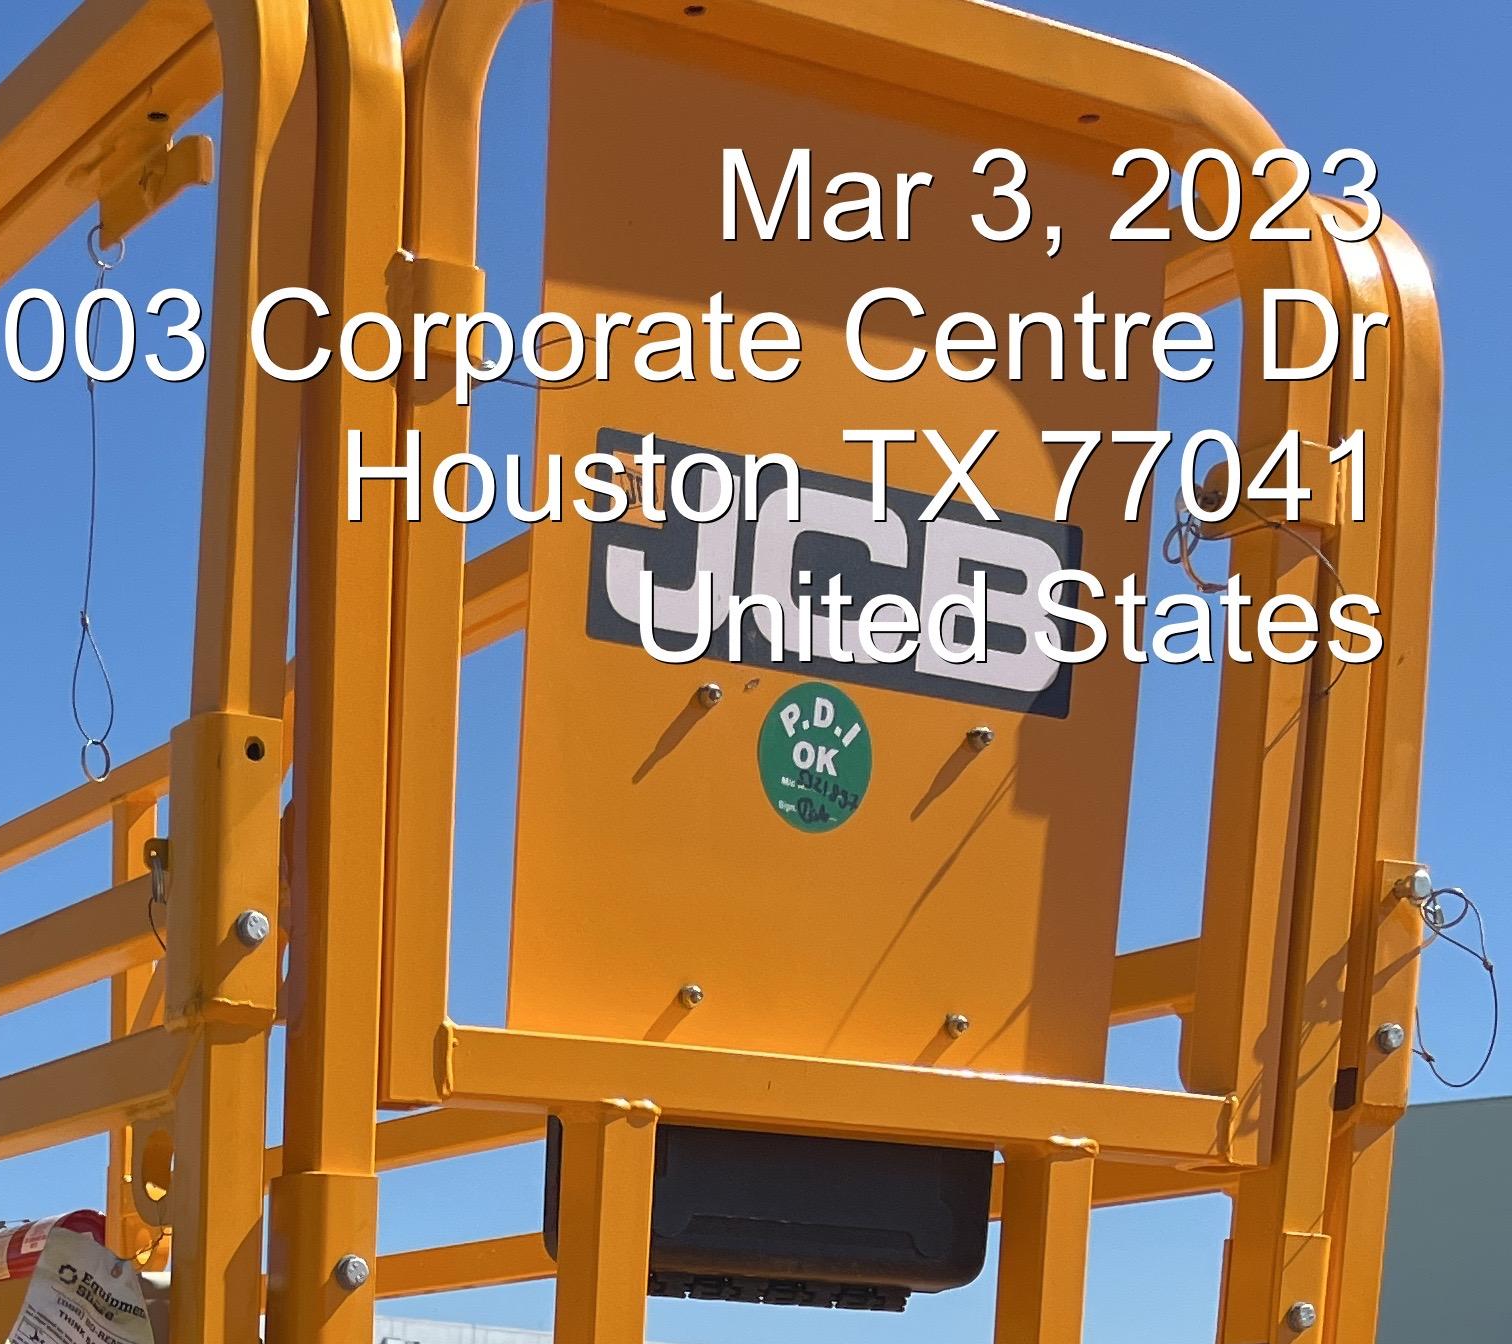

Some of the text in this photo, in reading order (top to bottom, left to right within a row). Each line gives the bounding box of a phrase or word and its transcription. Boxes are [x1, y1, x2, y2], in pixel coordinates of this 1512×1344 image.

[605, 468, 1062, 692] JCB
[792, 740, 840, 777] OK
[58, 1309, 87, 1339] THINK
